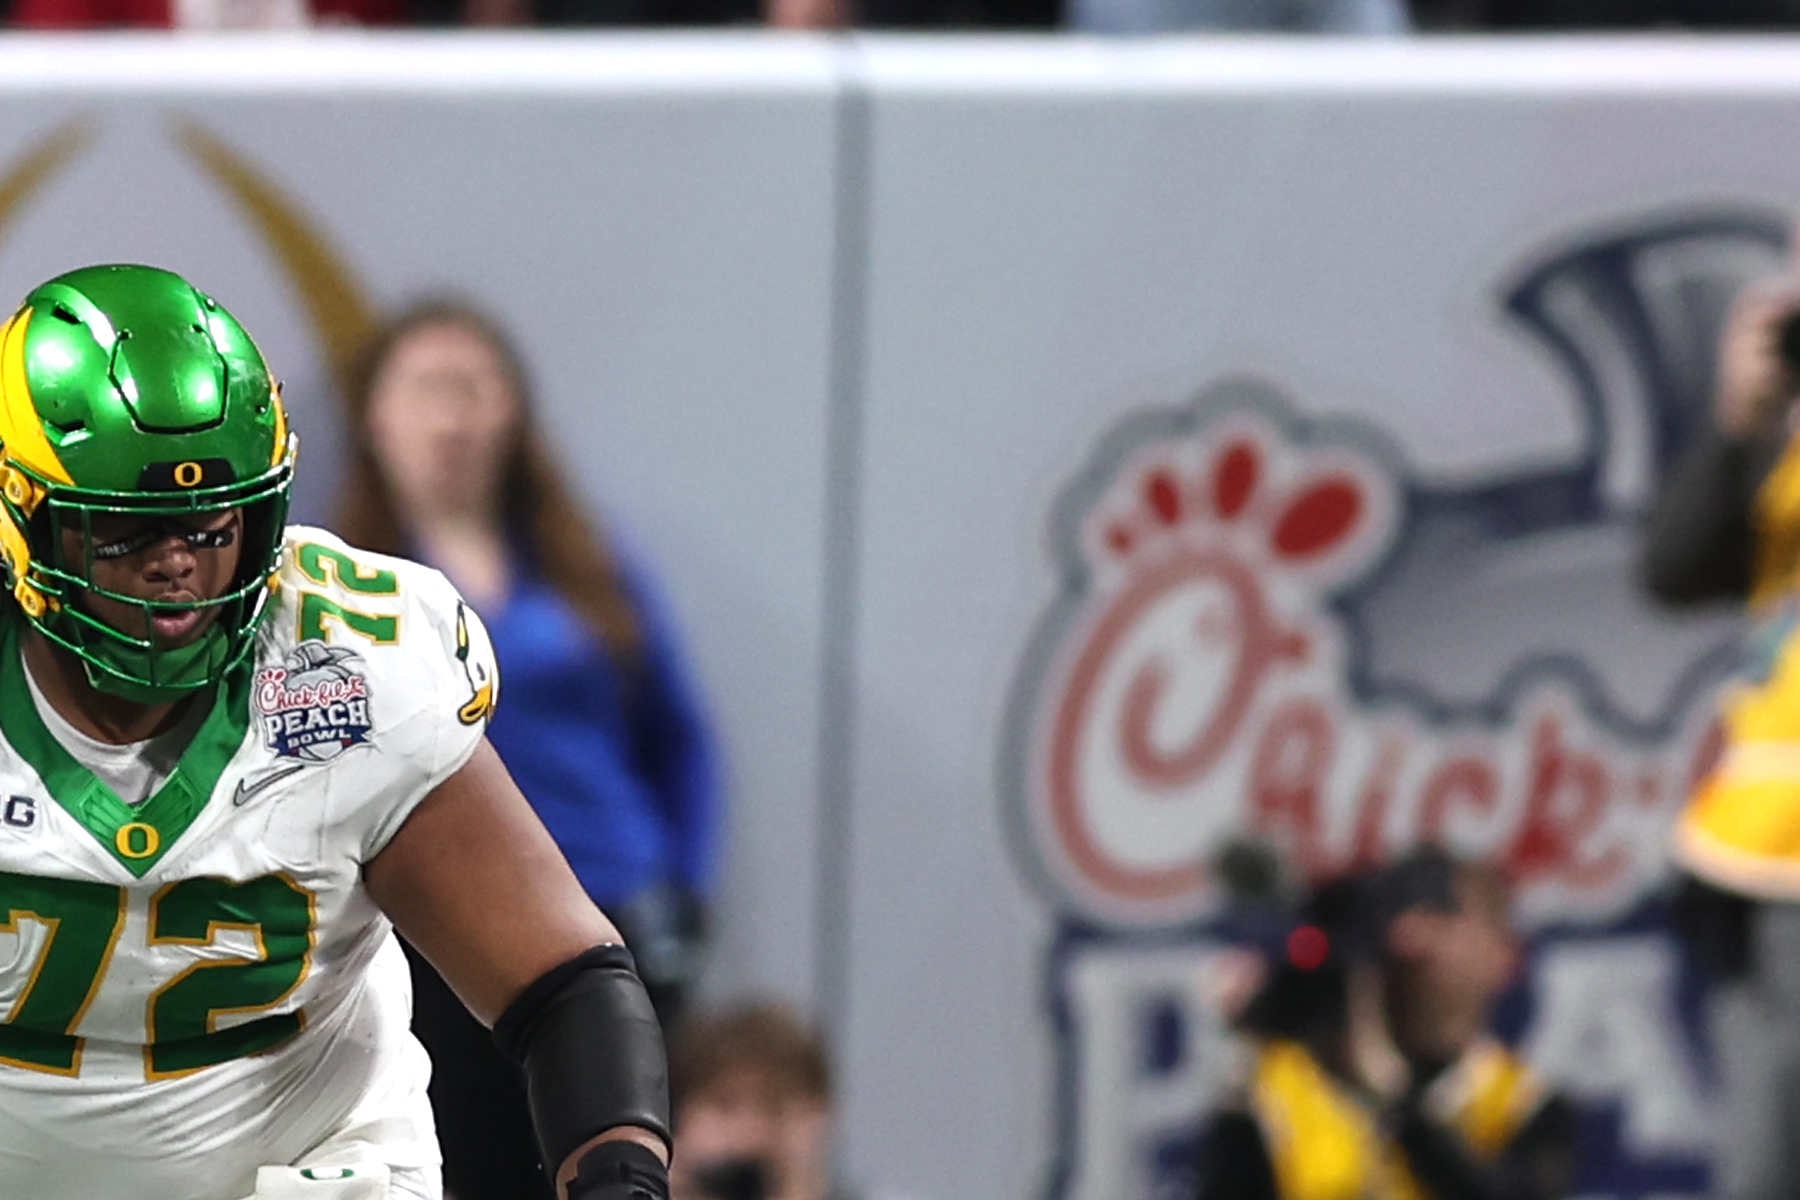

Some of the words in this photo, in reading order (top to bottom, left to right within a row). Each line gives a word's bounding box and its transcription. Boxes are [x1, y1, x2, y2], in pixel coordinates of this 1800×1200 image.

[174, 461, 203, 487] O
[293, 541, 403, 646] 72
[265, 699, 371, 743] PEACH
[287, 728, 352, 749] BOWL
[115, 822, 160, 859] O
